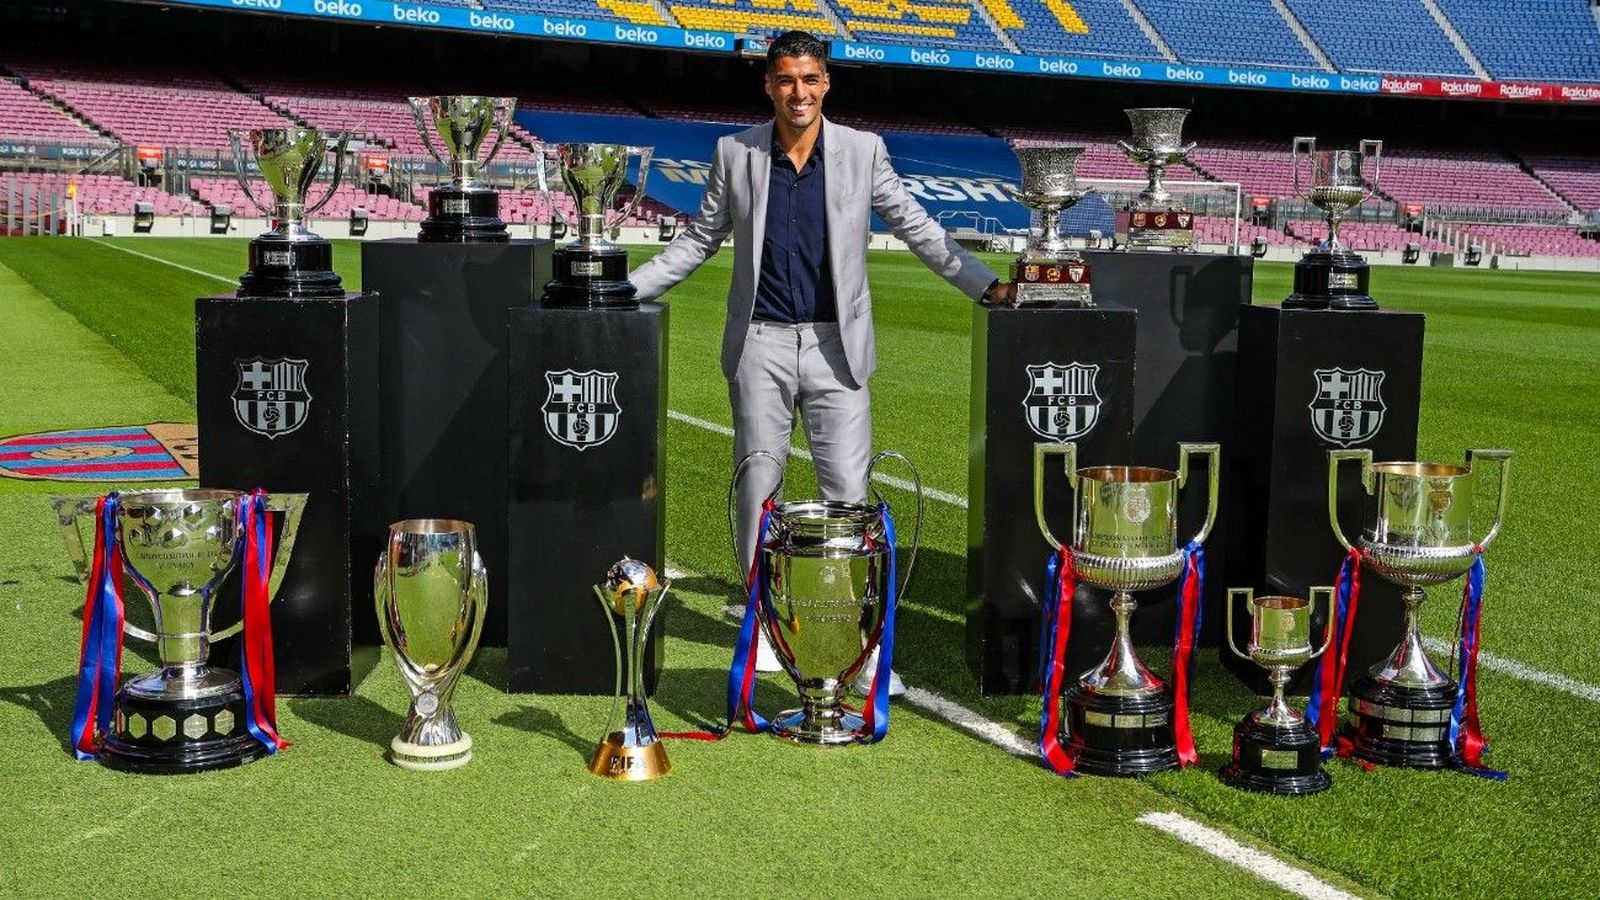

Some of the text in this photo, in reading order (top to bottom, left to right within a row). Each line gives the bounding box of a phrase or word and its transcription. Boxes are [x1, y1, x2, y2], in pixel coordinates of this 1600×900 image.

[314, 0, 362, 16] beko
[393, 4, 440, 23] beko
[470, 12, 515, 30] beko
[543, 19, 587, 37] beko
[615, 26, 658, 43] beko
[684, 31, 725, 48] beko
[845, 43, 1379, 91] beko beko beko beko beko beko beko beko beko
[1382, 79, 1600, 100] Rakuten Rakuten Rakuten Rakute
[257, 391, 286, 400] FCB
[1047, 396, 1077, 405] FCB
[1334, 400, 1362, 409] FCB
[567, 403, 596, 412] FCB
